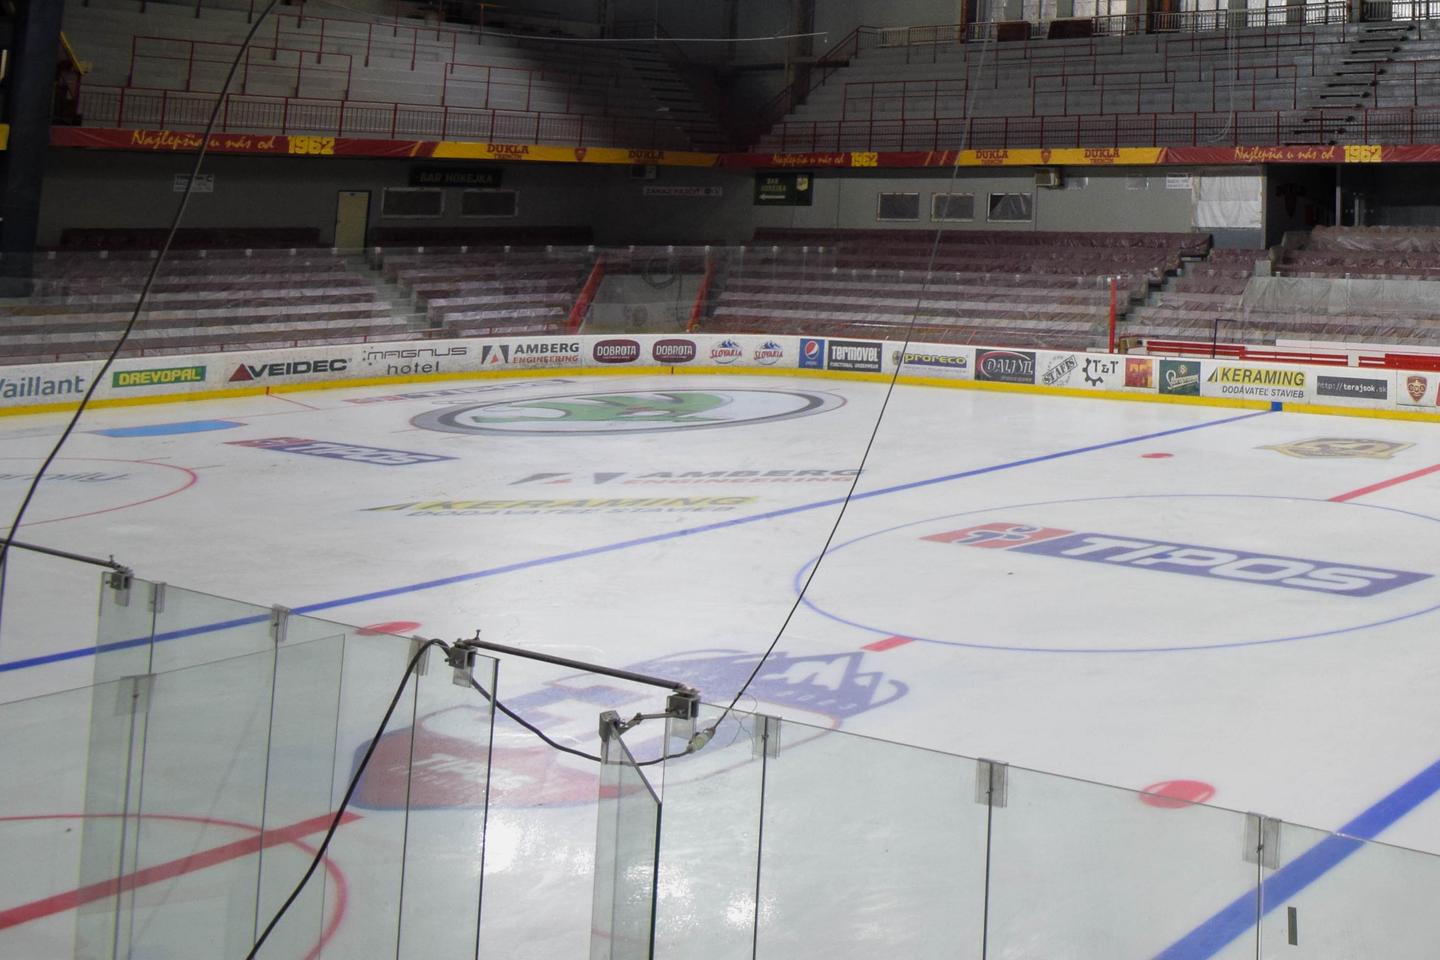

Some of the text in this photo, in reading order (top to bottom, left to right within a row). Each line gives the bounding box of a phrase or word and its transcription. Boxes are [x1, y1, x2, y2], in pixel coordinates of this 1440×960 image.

[287, 136, 335, 155] 1962
[486, 143, 529, 154] DUKLA
[628, 150, 664, 160] DUKLA
[851, 152, 878, 167] 1962
[975, 149, 1008, 160] DUKLA
[1084, 149, 1120, 158] DUKLA
[1344, 145, 1382, 162] 1962
[514, 343, 579, 354] AMBERG
[512, 354, 579, 364] ENGINEERING
[904, 353, 966, 365] proreco
[249, 359, 348, 378] VEIDEC
[387, 361, 440, 376] hotel
[119, 368, 201, 385] DREVOPAL
[1220, 367, 1305, 386] KERAMING
[1271, 387, 1304, 399] STAVIEB
[639, 469, 866, 478] AMBERG
[420, 497, 752, 510] KERAMING
[1061, 537, 1398, 591] TIPOS
